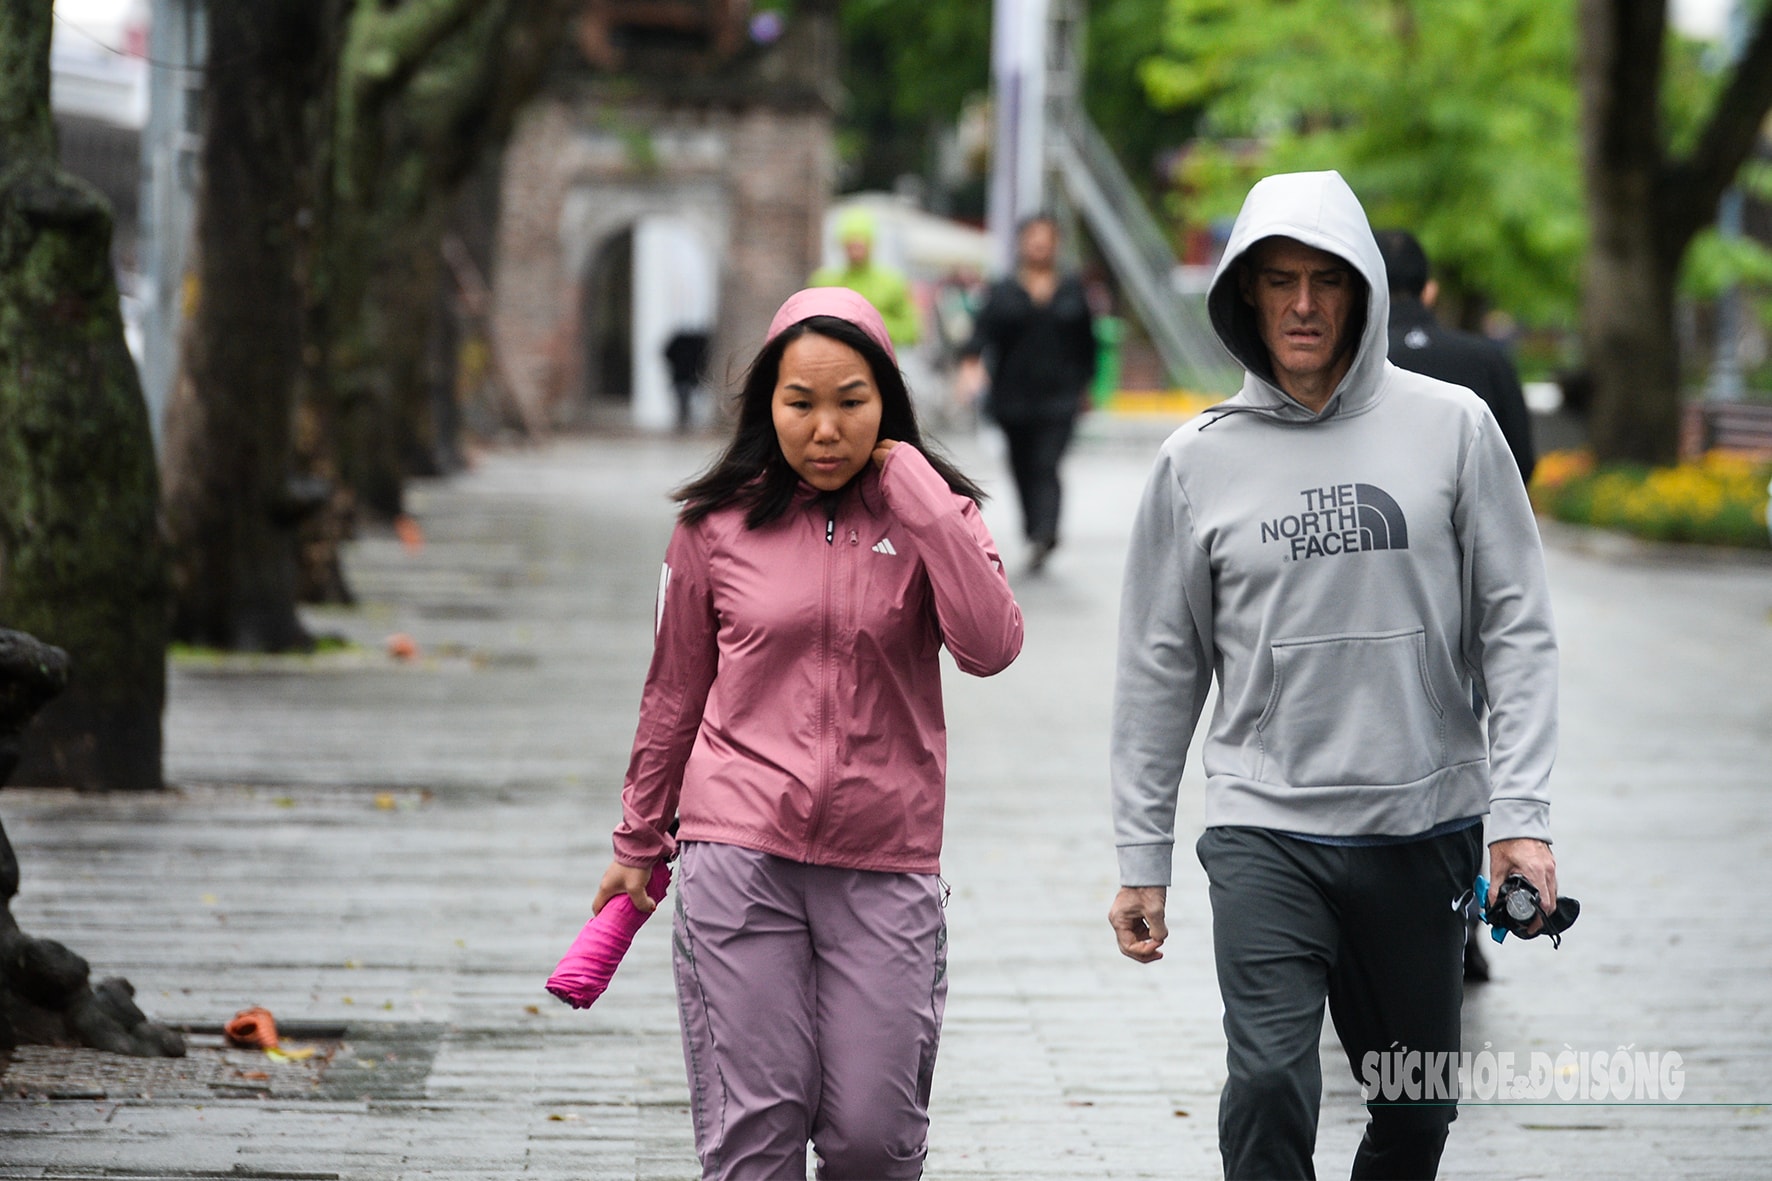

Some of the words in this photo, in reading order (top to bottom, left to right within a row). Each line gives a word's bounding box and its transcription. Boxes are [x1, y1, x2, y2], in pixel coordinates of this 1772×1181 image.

[1301, 484, 1354, 511] THE
[1261, 507, 1357, 543] NORTH
[1291, 530, 1359, 561] FACE
